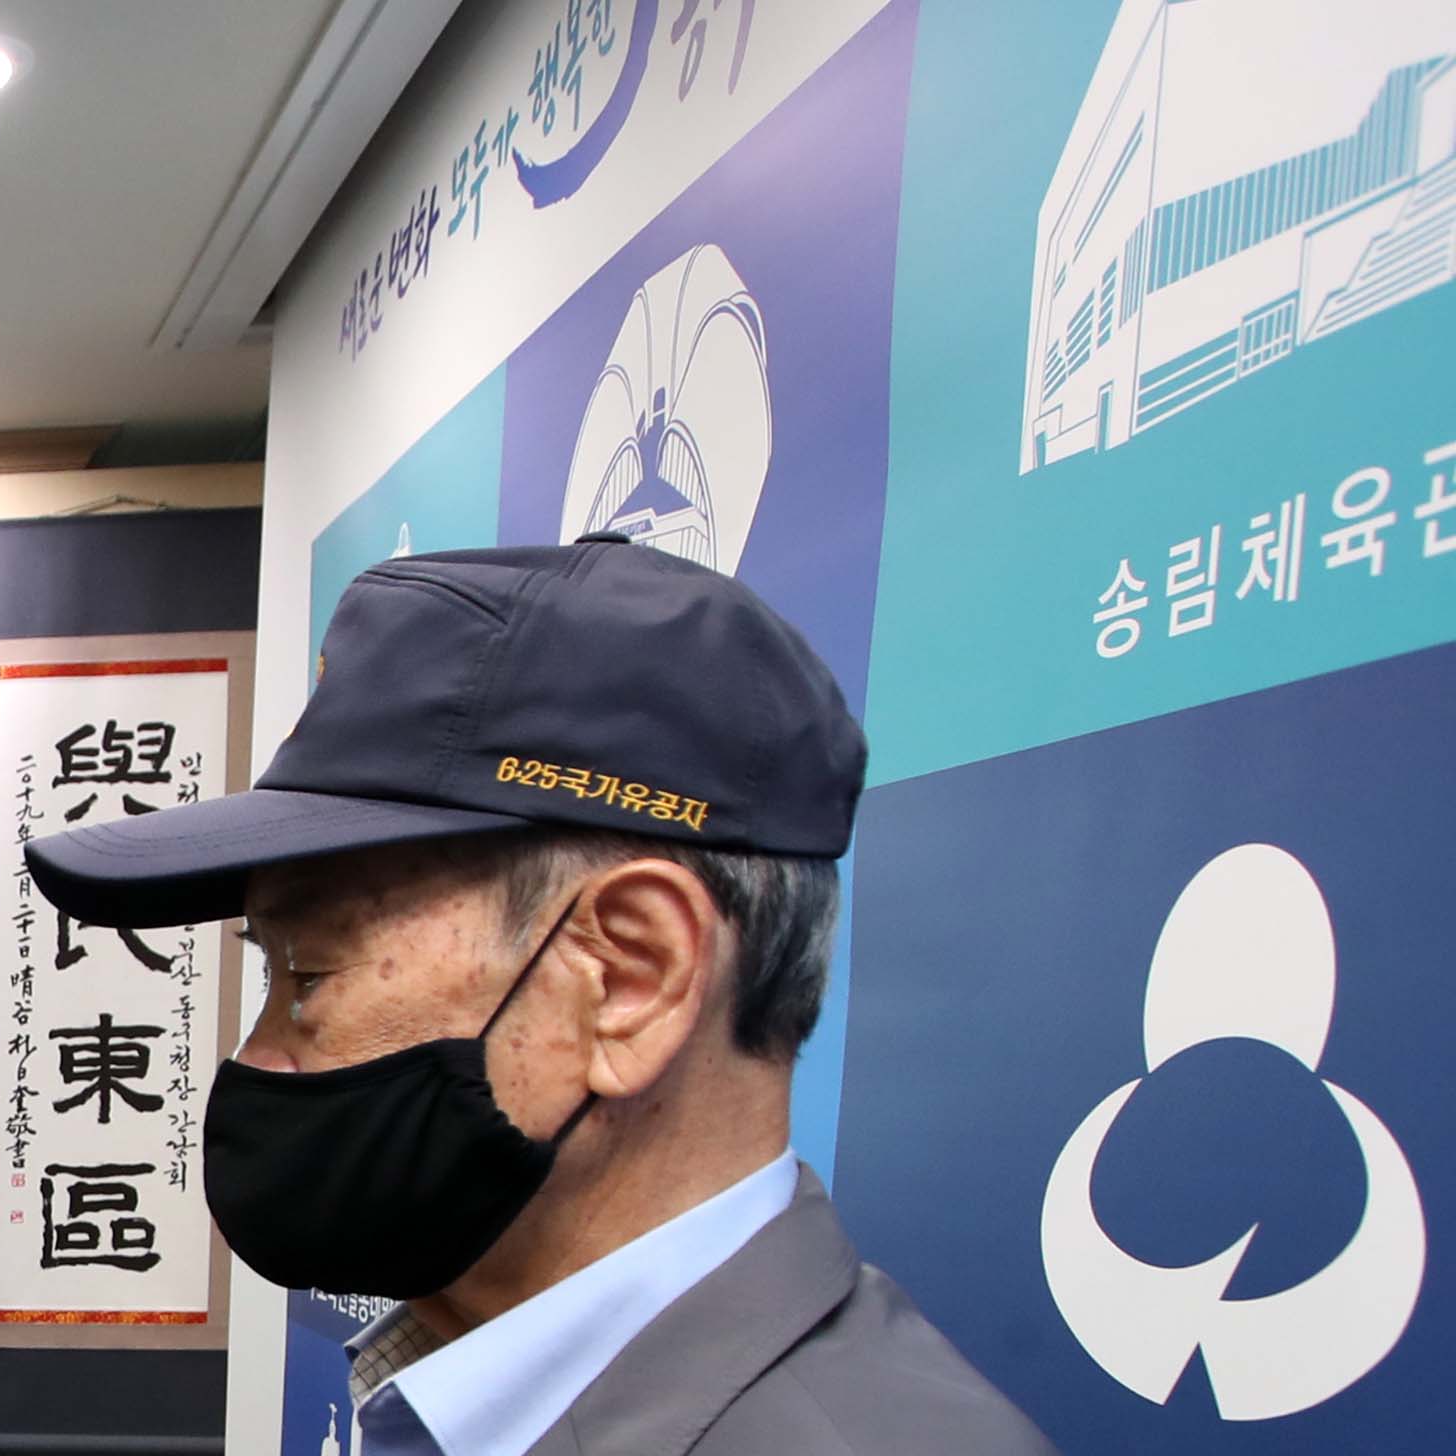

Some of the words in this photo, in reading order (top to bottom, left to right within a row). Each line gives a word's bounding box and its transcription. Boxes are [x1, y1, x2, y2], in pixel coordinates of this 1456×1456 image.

[338, 252, 384, 362] 새로운
[388, 185, 440, 299] 변화
[448, 106, 520, 240] 모두가
